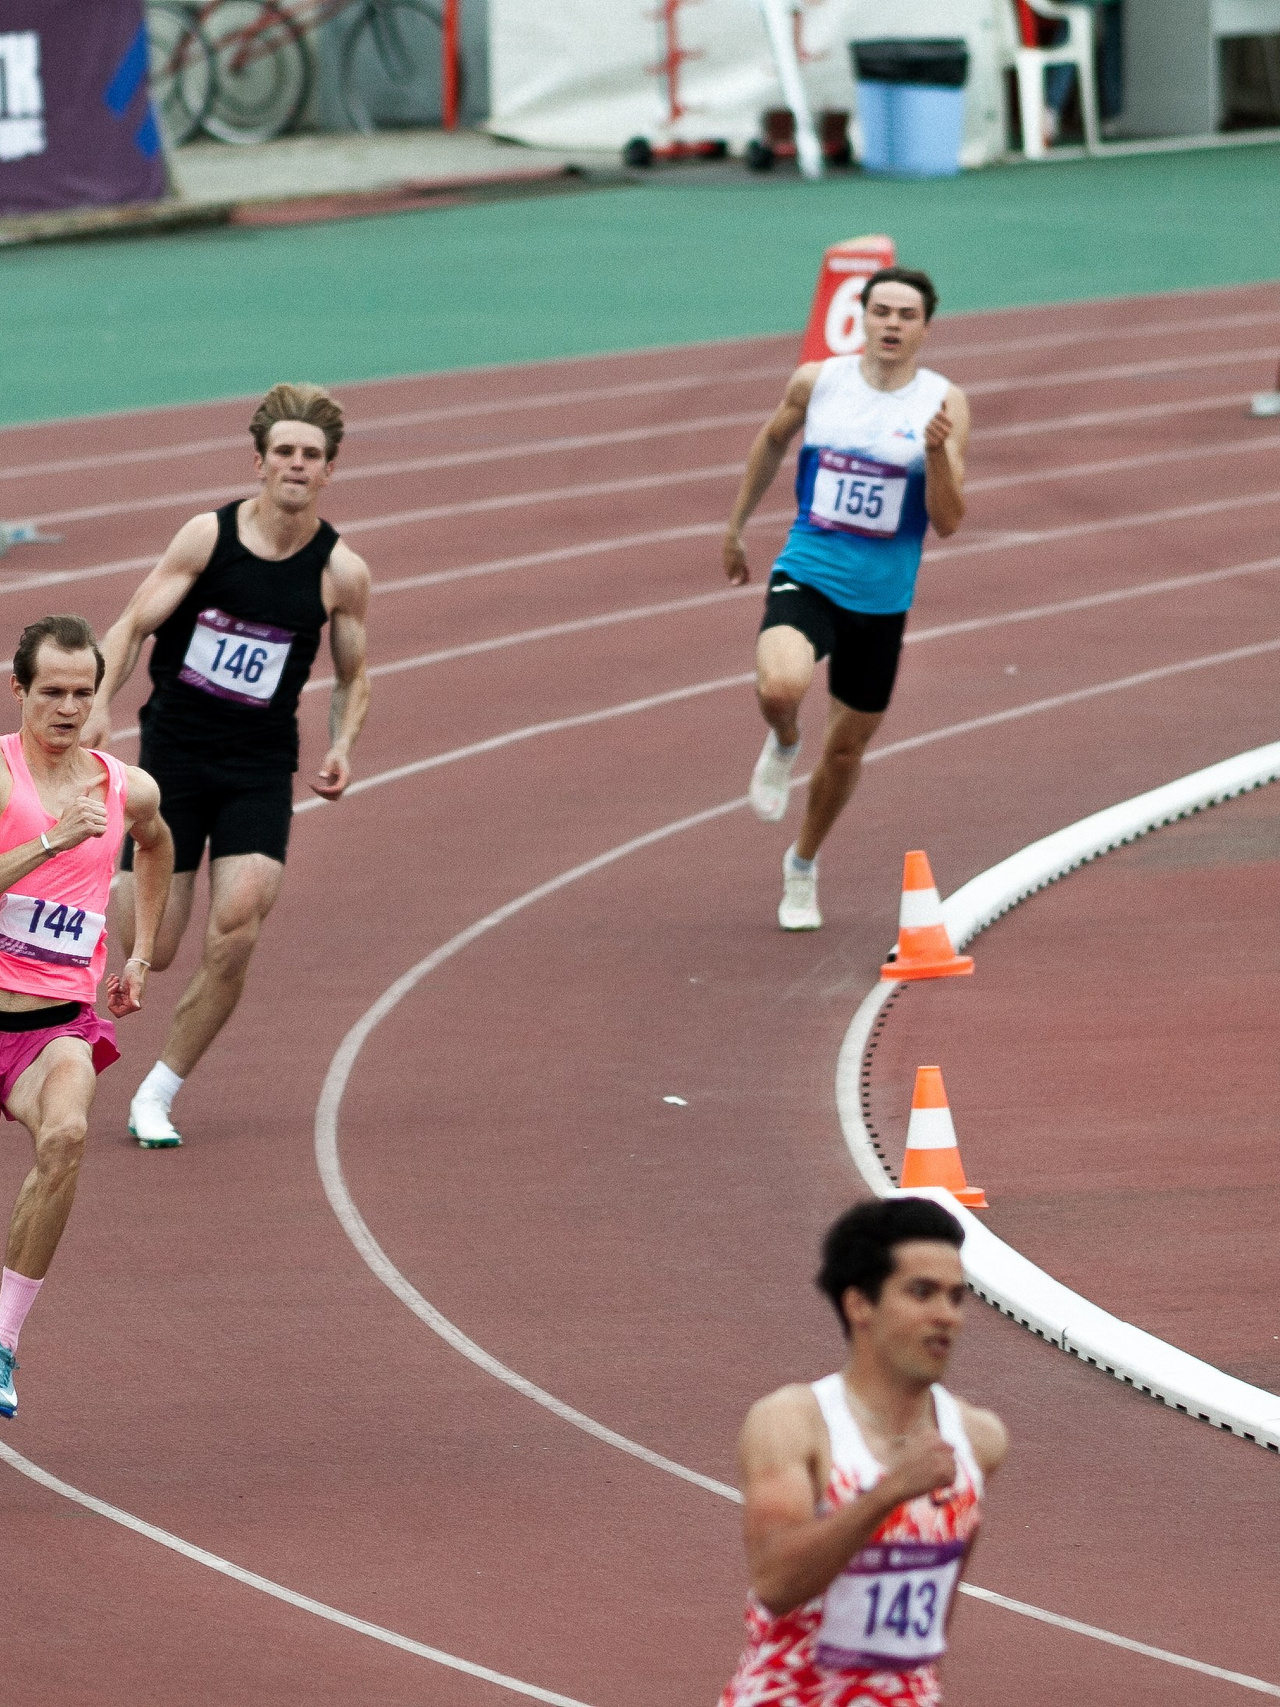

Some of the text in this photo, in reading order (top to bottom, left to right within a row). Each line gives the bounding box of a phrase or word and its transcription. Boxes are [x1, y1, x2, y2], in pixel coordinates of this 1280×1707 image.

[825, 276, 867, 353] 6
[834, 479, 885, 519] 155
[211, 637, 268, 684] 146
[28, 899, 87, 941] 144
[864, 1580, 937, 1638] 143
